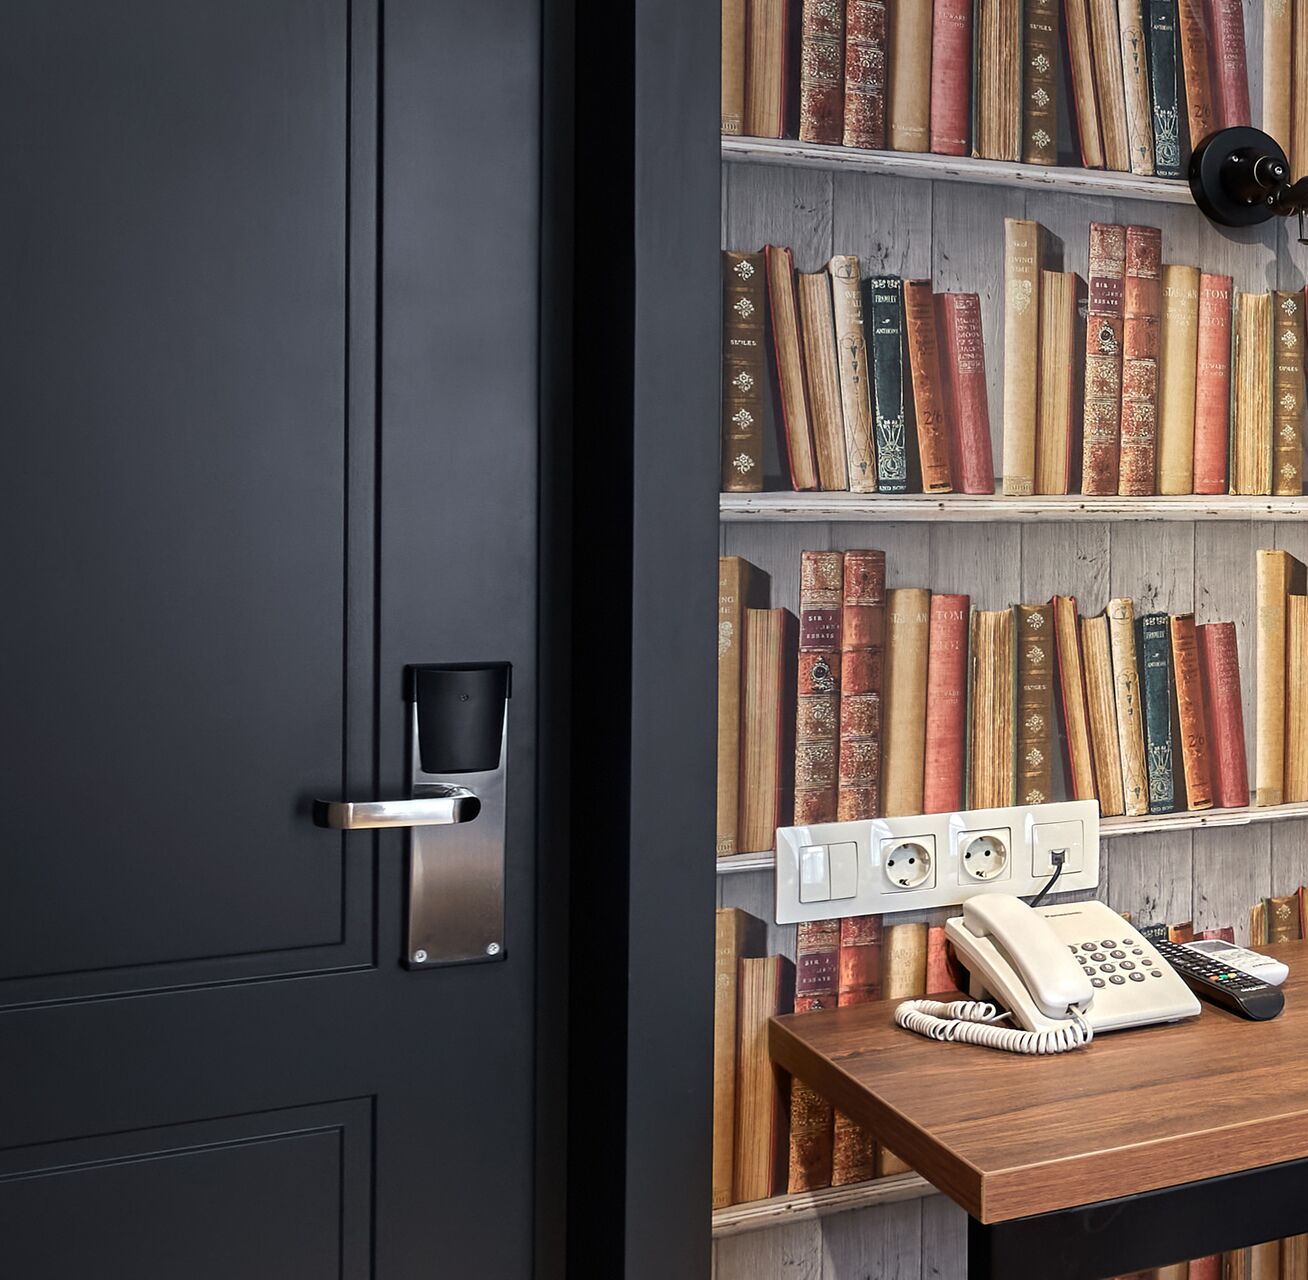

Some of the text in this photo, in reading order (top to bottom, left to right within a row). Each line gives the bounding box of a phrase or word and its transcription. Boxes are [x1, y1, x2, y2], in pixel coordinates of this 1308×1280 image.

[1205, 288, 1228, 299] TOM
[923, 410, 943, 426] 2/6
[936, 610, 963, 621] TOM
